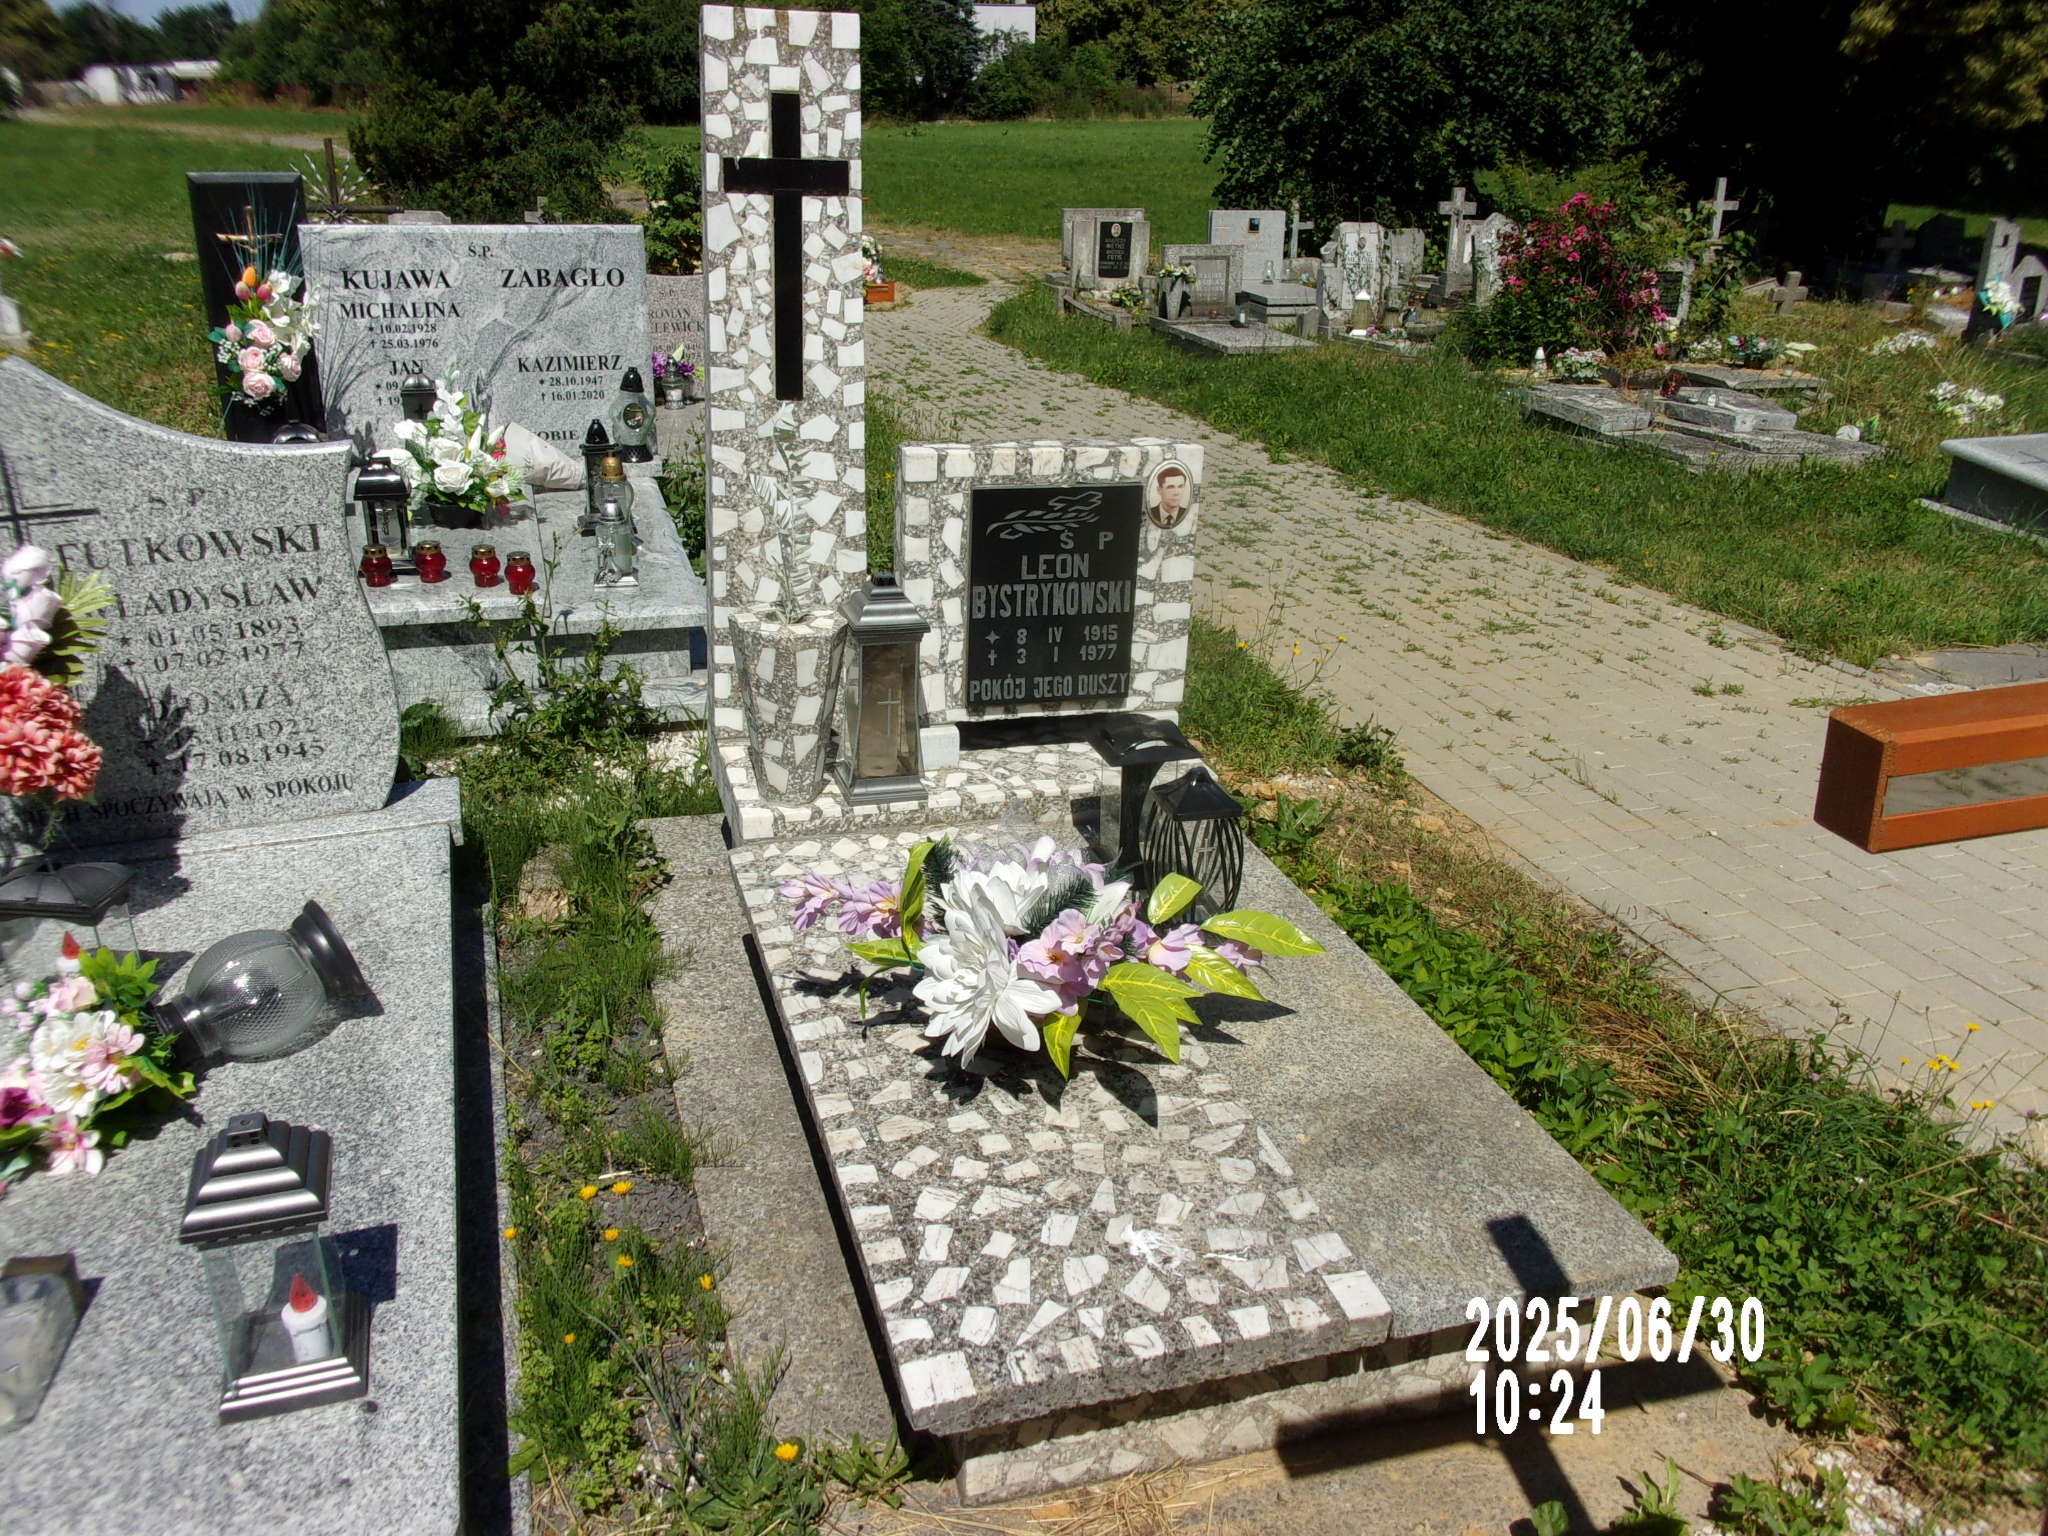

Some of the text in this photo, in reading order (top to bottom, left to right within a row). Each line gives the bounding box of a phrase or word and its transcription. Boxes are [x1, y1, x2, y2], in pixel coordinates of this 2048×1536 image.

[467, 241, 494, 258] Ś.P.
[341, 269, 453, 290] KUJAWA
[501, 267, 625, 288] ZABAGŁO
[340, 301, 461, 319] MICHALINA
[381, 338, 440, 350] 25.03.1976
[388, 359, 426, 377] JAN
[517, 354, 623, 373] KAZIMIERZ
[549, 376, 604, 387] 28.10.1947
[550, 390, 606, 401] 16.01.2020
[535, 430, 580, 441] OBIE
[1060, 529, 1114, 550] Ś P
[1020, 553, 1090, 580] LEON
[971, 580, 1132, 619] BYSTRYKOWSKI
[1016, 624, 1119, 645] 8 IV 1915
[1016, 648, 1027, 665] 3
[1079, 643, 1118, 661] 1977
[969, 672, 1130, 702] POKÓJ JEGO DUSZY
[235, 785, 253, 801] W
[264, 773, 354, 800] SPOKOJU
